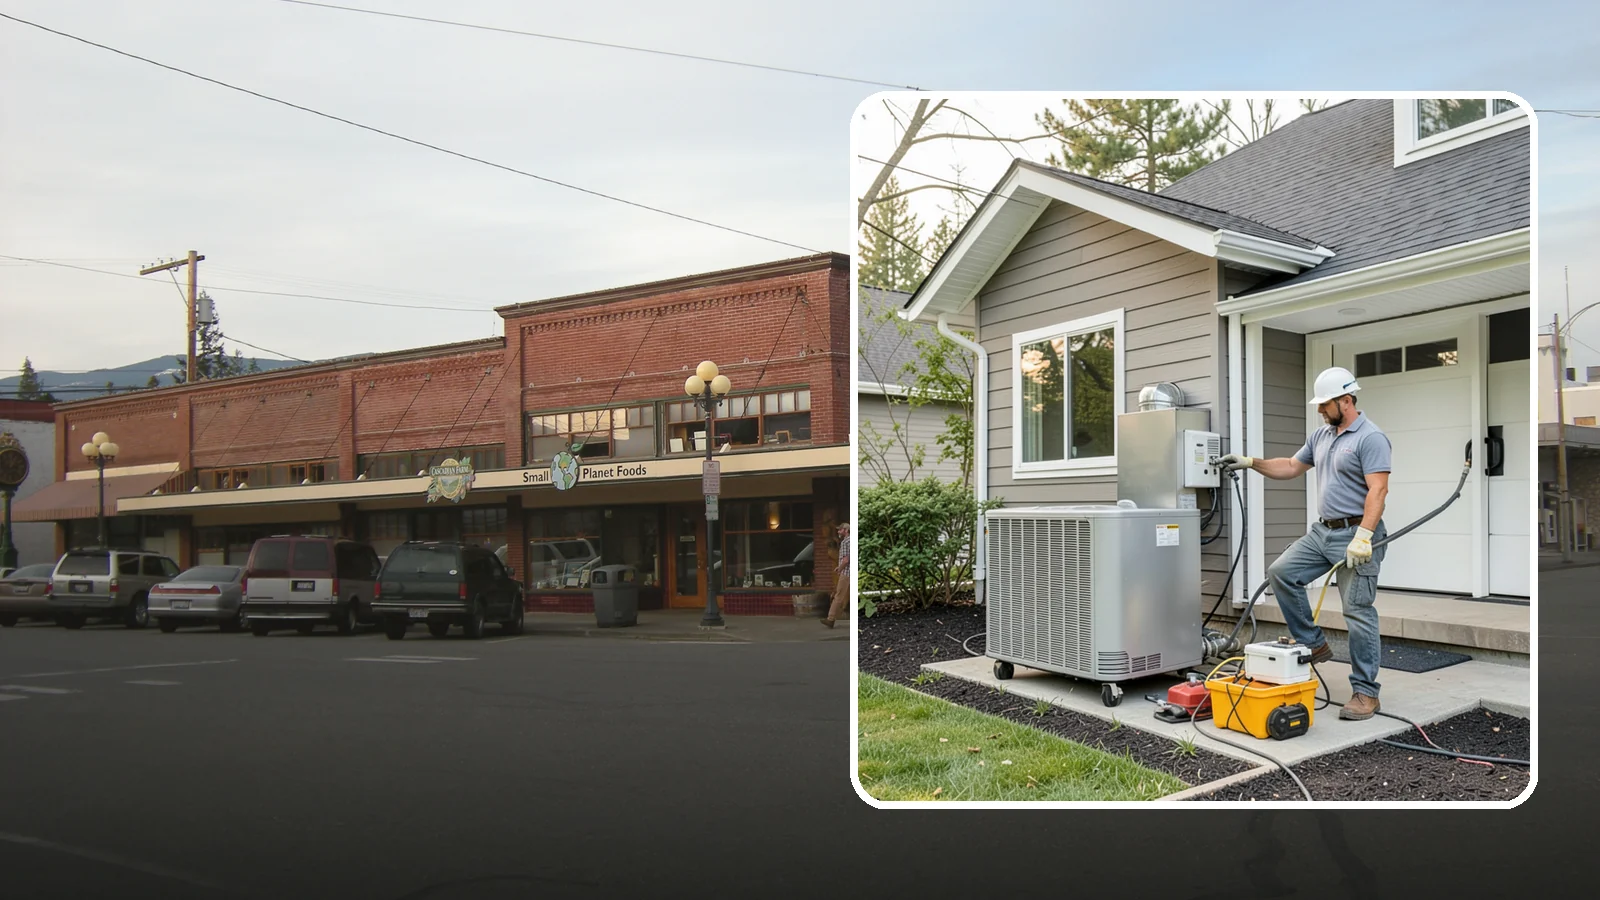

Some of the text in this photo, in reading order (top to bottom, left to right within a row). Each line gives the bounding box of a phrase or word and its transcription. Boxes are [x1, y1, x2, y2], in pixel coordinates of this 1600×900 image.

[431, 466, 456, 476] CASCADIAN
[523, 464, 647, 483] Small Planet Foods
